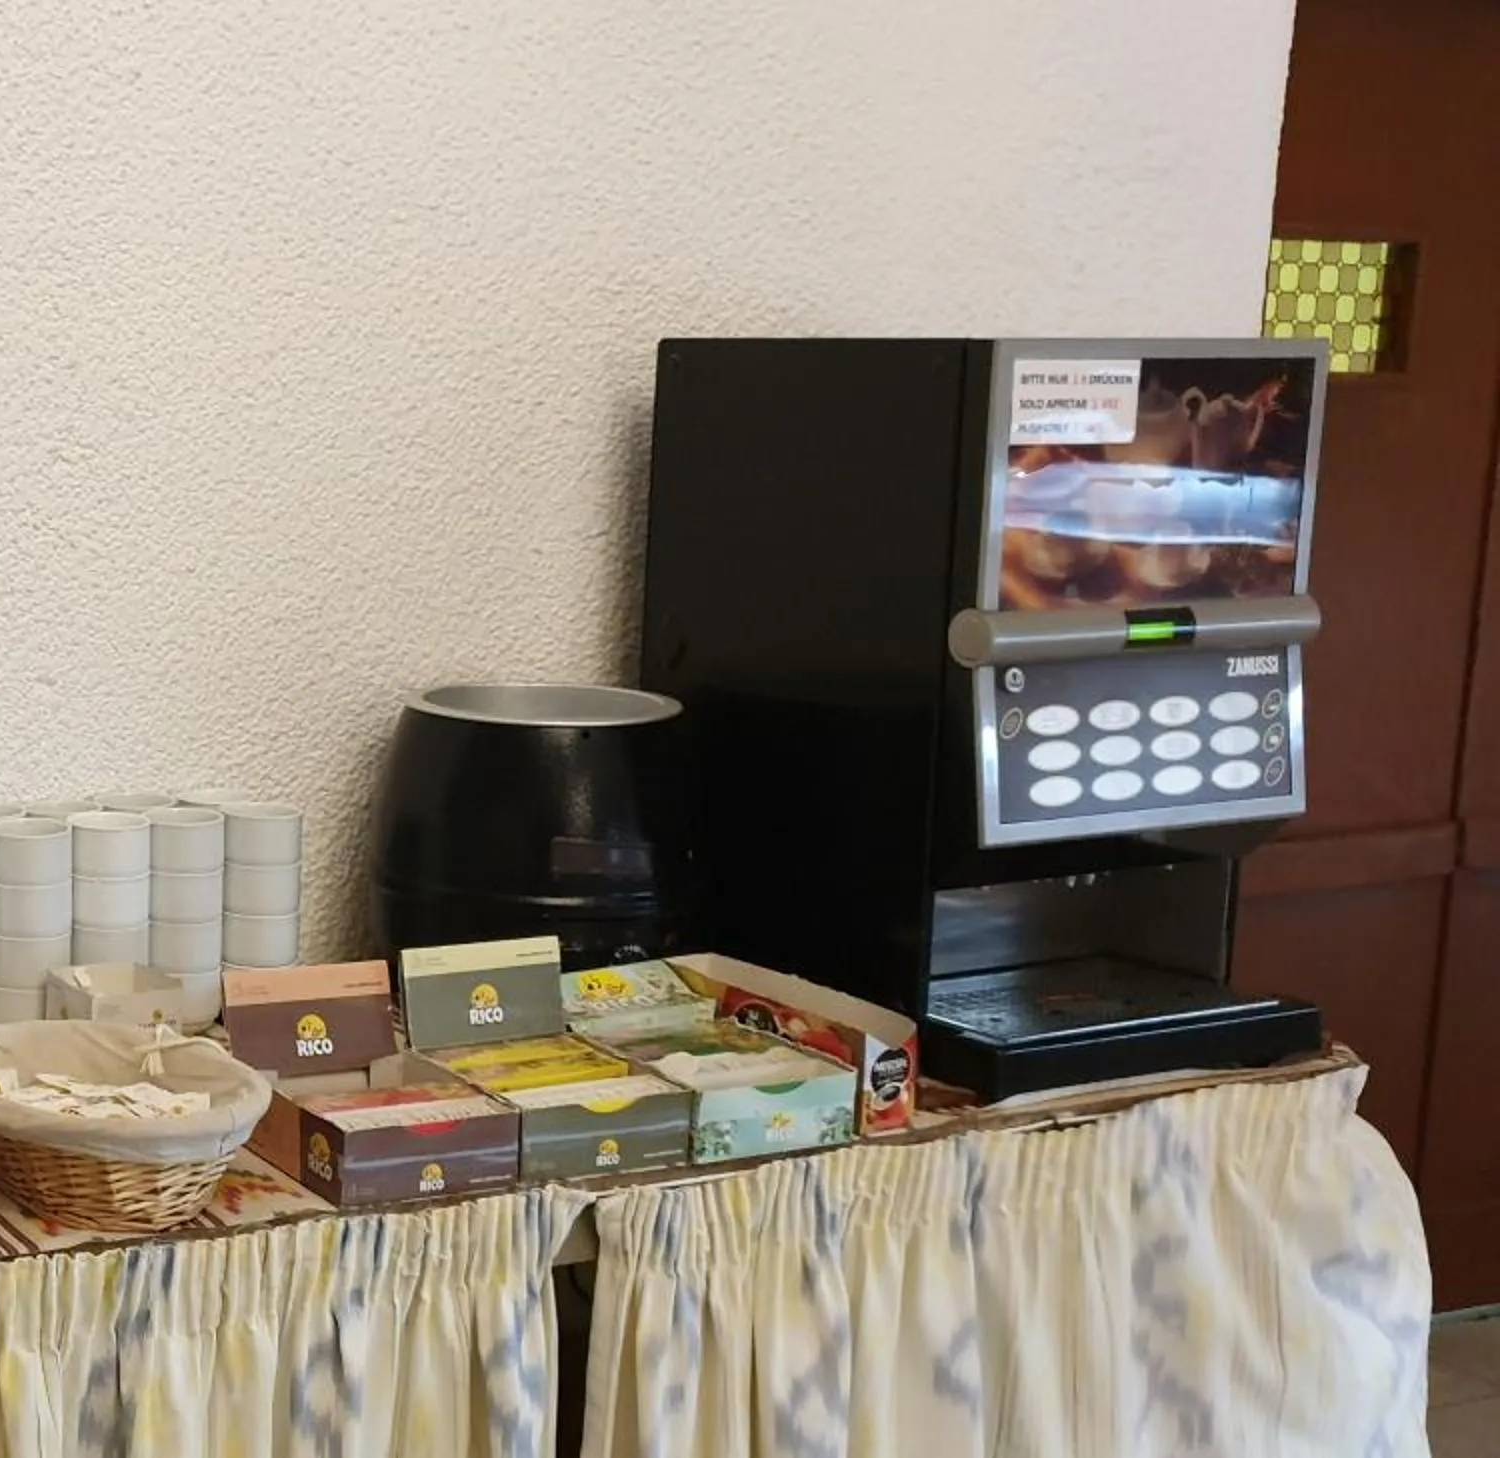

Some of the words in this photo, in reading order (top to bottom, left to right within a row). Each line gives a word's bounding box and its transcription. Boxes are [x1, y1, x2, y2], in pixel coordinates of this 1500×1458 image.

[1226, 656, 1279, 677] ZANUSSI
[468, 1007, 503, 1025] RICO
[296, 1039, 333, 1057] RICO
[307, 1153, 333, 1182] RICO
[596, 1154, 621, 1167] RICO
[419, 1179, 445, 1192] RICO
